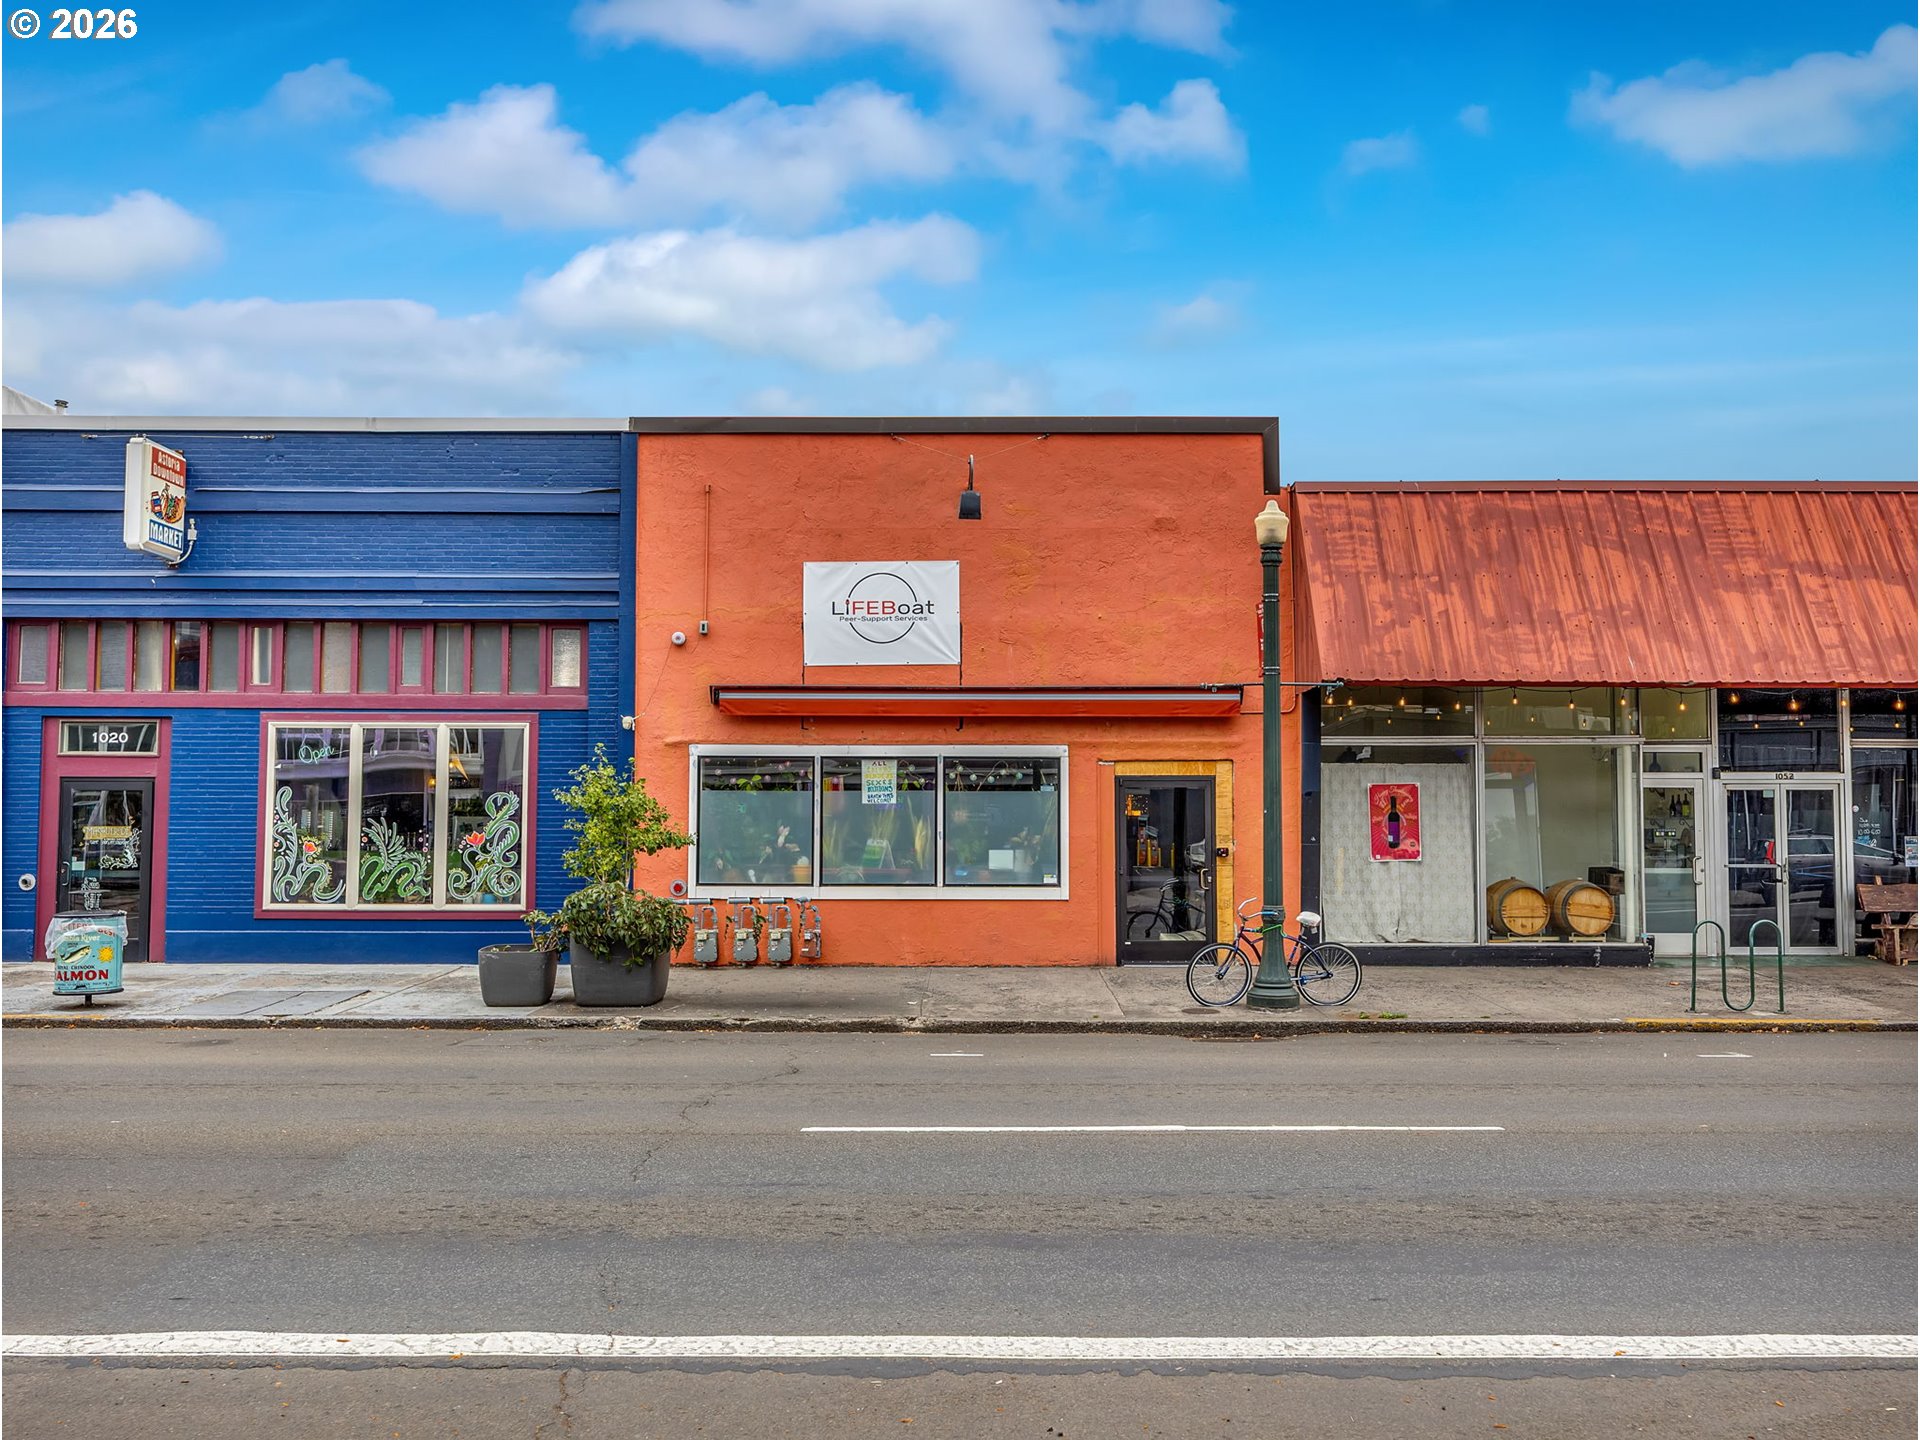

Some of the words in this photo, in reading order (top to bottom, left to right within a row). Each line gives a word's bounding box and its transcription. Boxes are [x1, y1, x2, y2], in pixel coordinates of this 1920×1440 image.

[150, 523, 183, 549] MARKET
[831, 599, 935, 615] LiFEBoat
[92, 732, 129, 744] 1020
[299, 745, 335, 764] Open
[56, 969, 109, 981] ALMON
